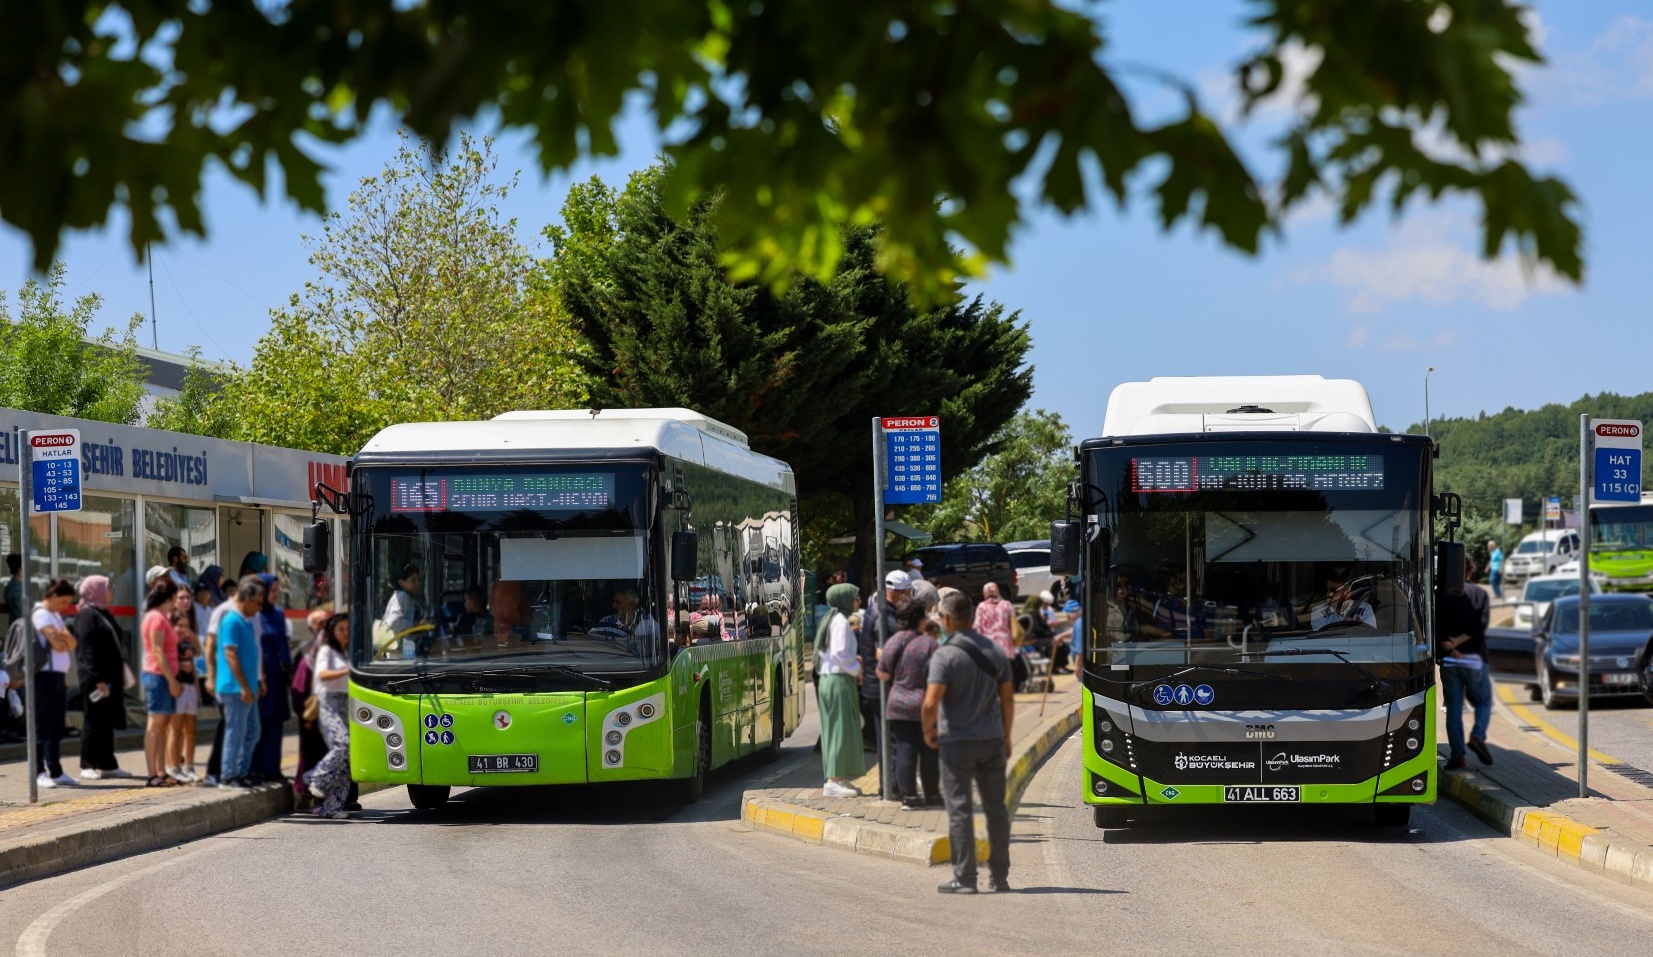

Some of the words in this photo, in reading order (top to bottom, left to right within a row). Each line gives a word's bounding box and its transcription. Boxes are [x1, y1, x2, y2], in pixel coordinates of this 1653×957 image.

[1600, 426, 1630, 434] PERON
[132, 446, 208, 486] BELEDİYESİ
[1609, 455, 1631, 465] HAT
[1138, 462, 1188, 488] 600
[1613, 470, 1627, 479] 33
[1602, 483, 1621, 493] 115
[1624, 484, 1639, 494] (Ç)
[398, 482, 438, 508] 145
[476, 758, 488, 769] 41
[496, 757, 509, 768] BR
[515, 757, 534, 768] 430
[1227, 788, 1240, 800] 41
[1244, 788, 1269, 800] ALL
[1273, 788, 1296, 800] 663
